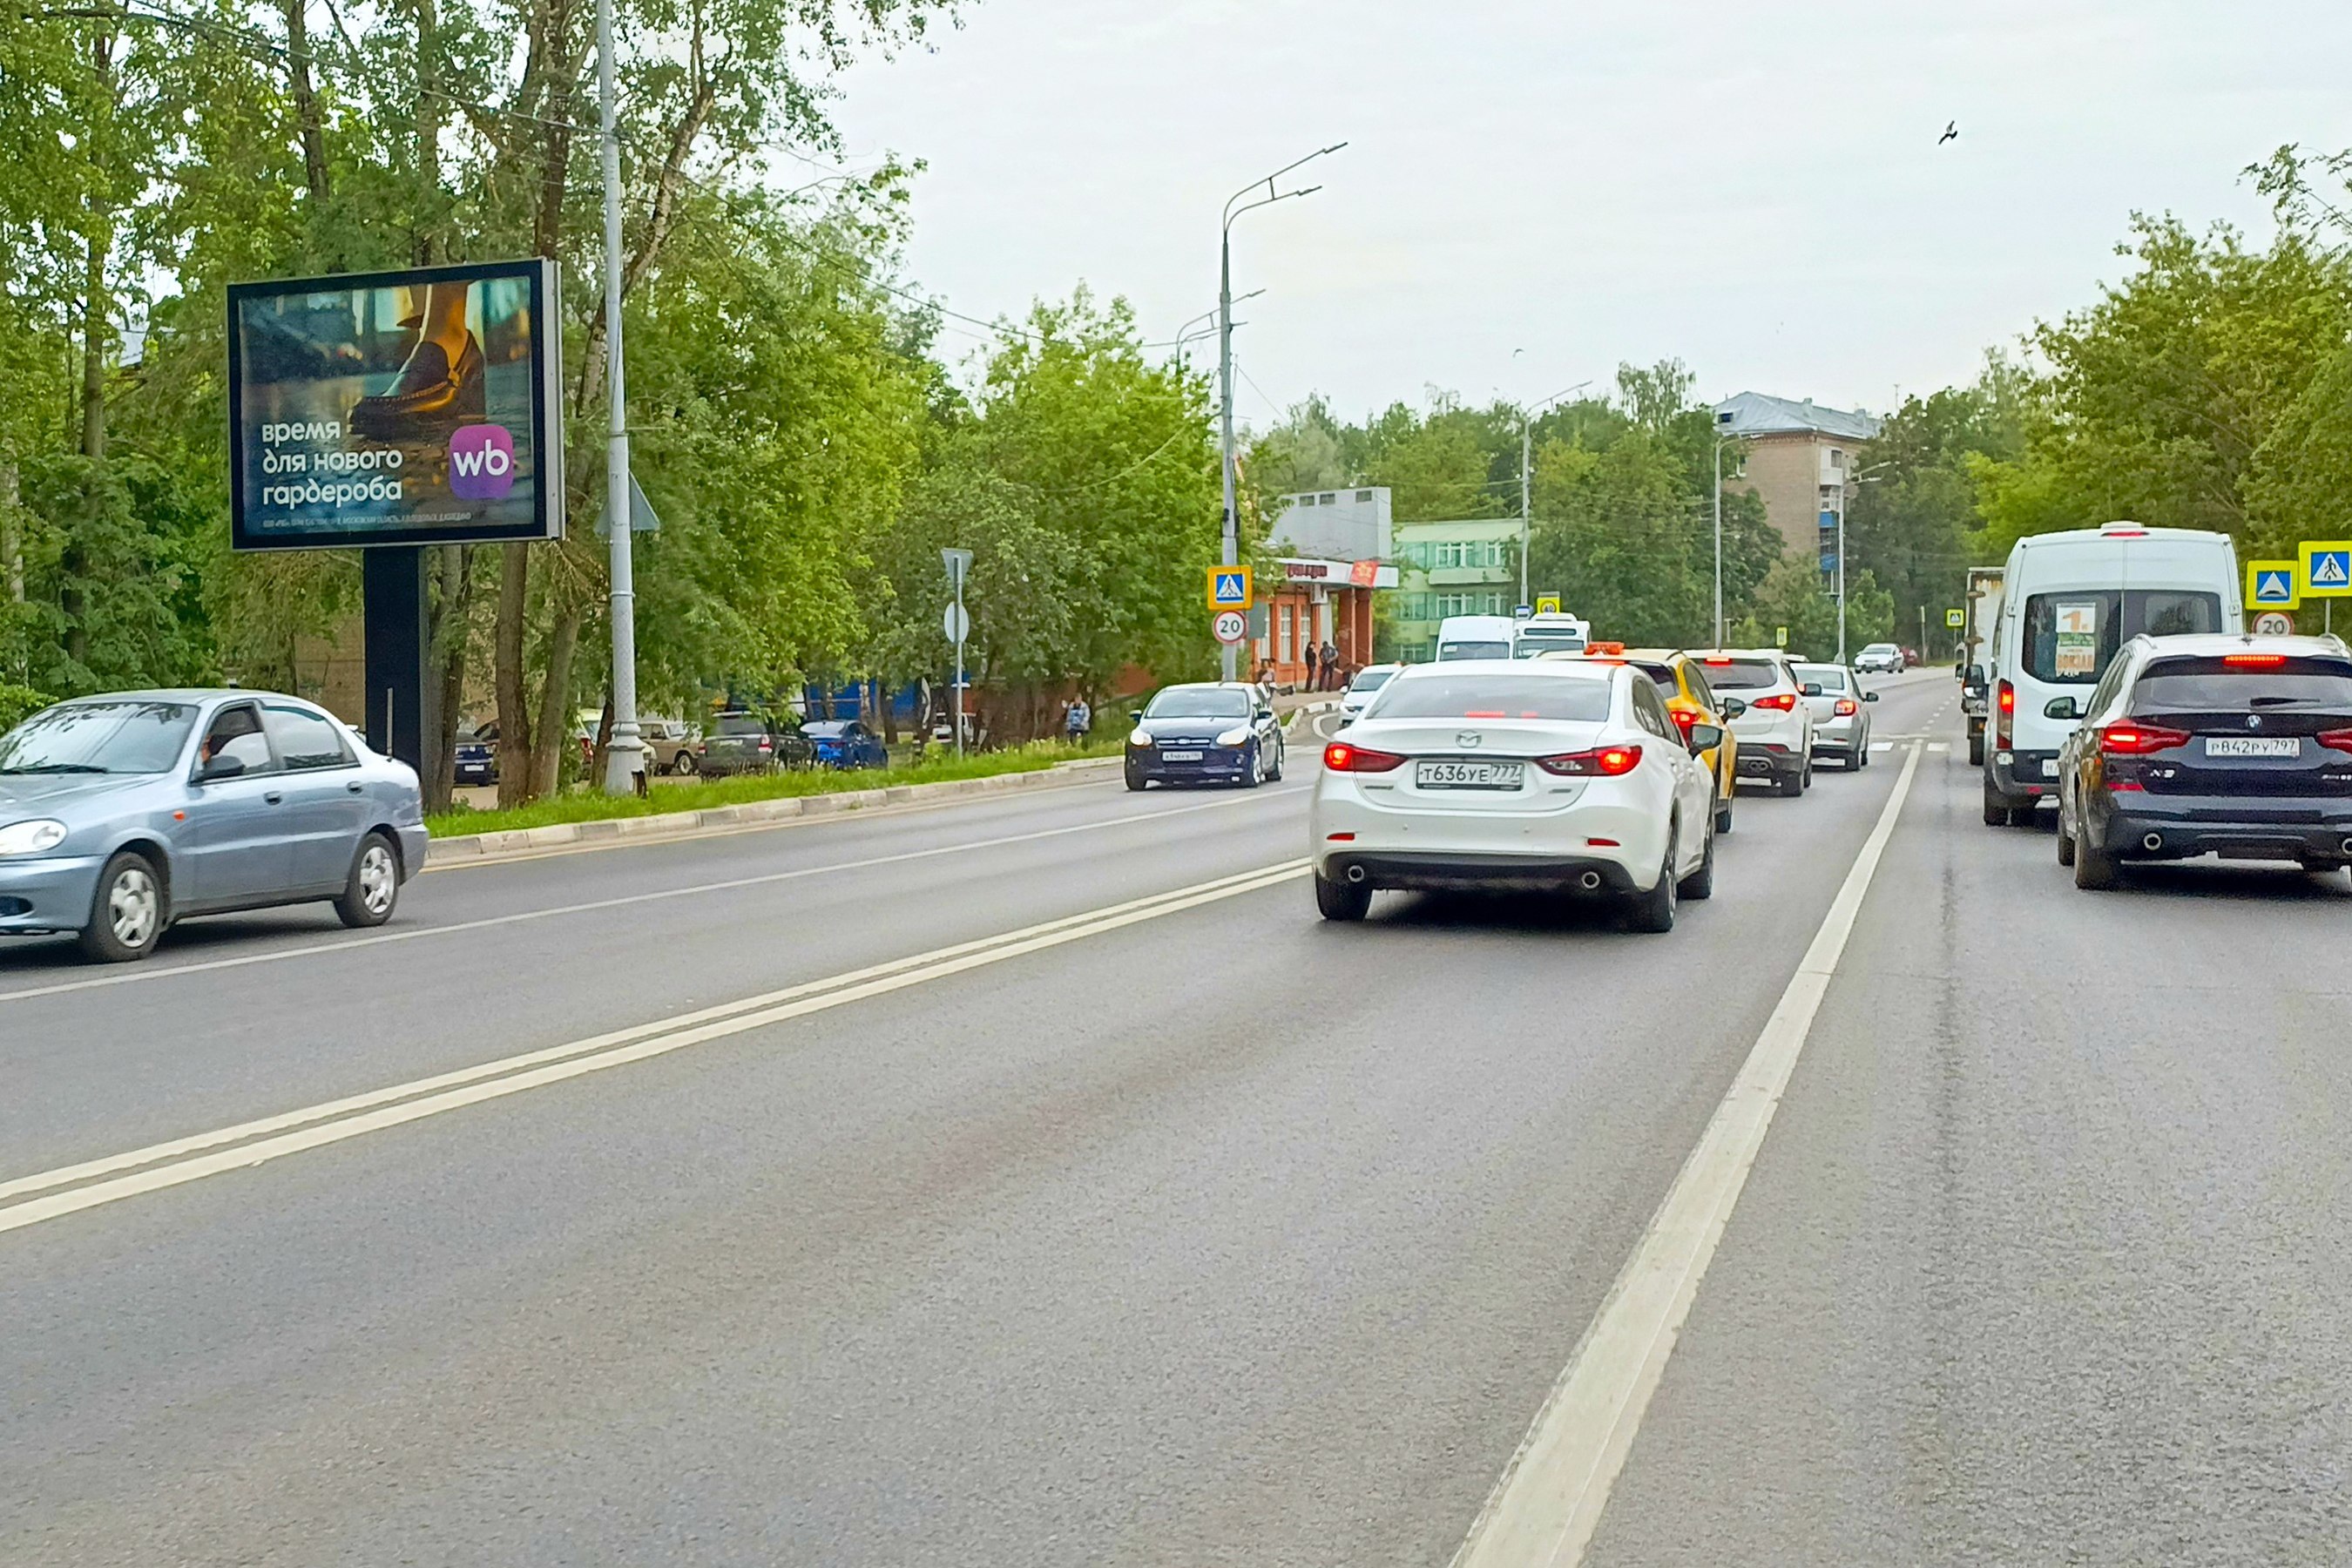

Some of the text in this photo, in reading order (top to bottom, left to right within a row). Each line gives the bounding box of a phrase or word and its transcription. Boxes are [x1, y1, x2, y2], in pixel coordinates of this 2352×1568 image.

[262, 421, 341, 448] время
[262, 449, 402, 474] для нового
[453, 438, 510, 477] wb
[263, 475, 402, 510] гардероба
[1220, 619, 1240, 633] 20
[2262, 619, 2285, 635] 20
